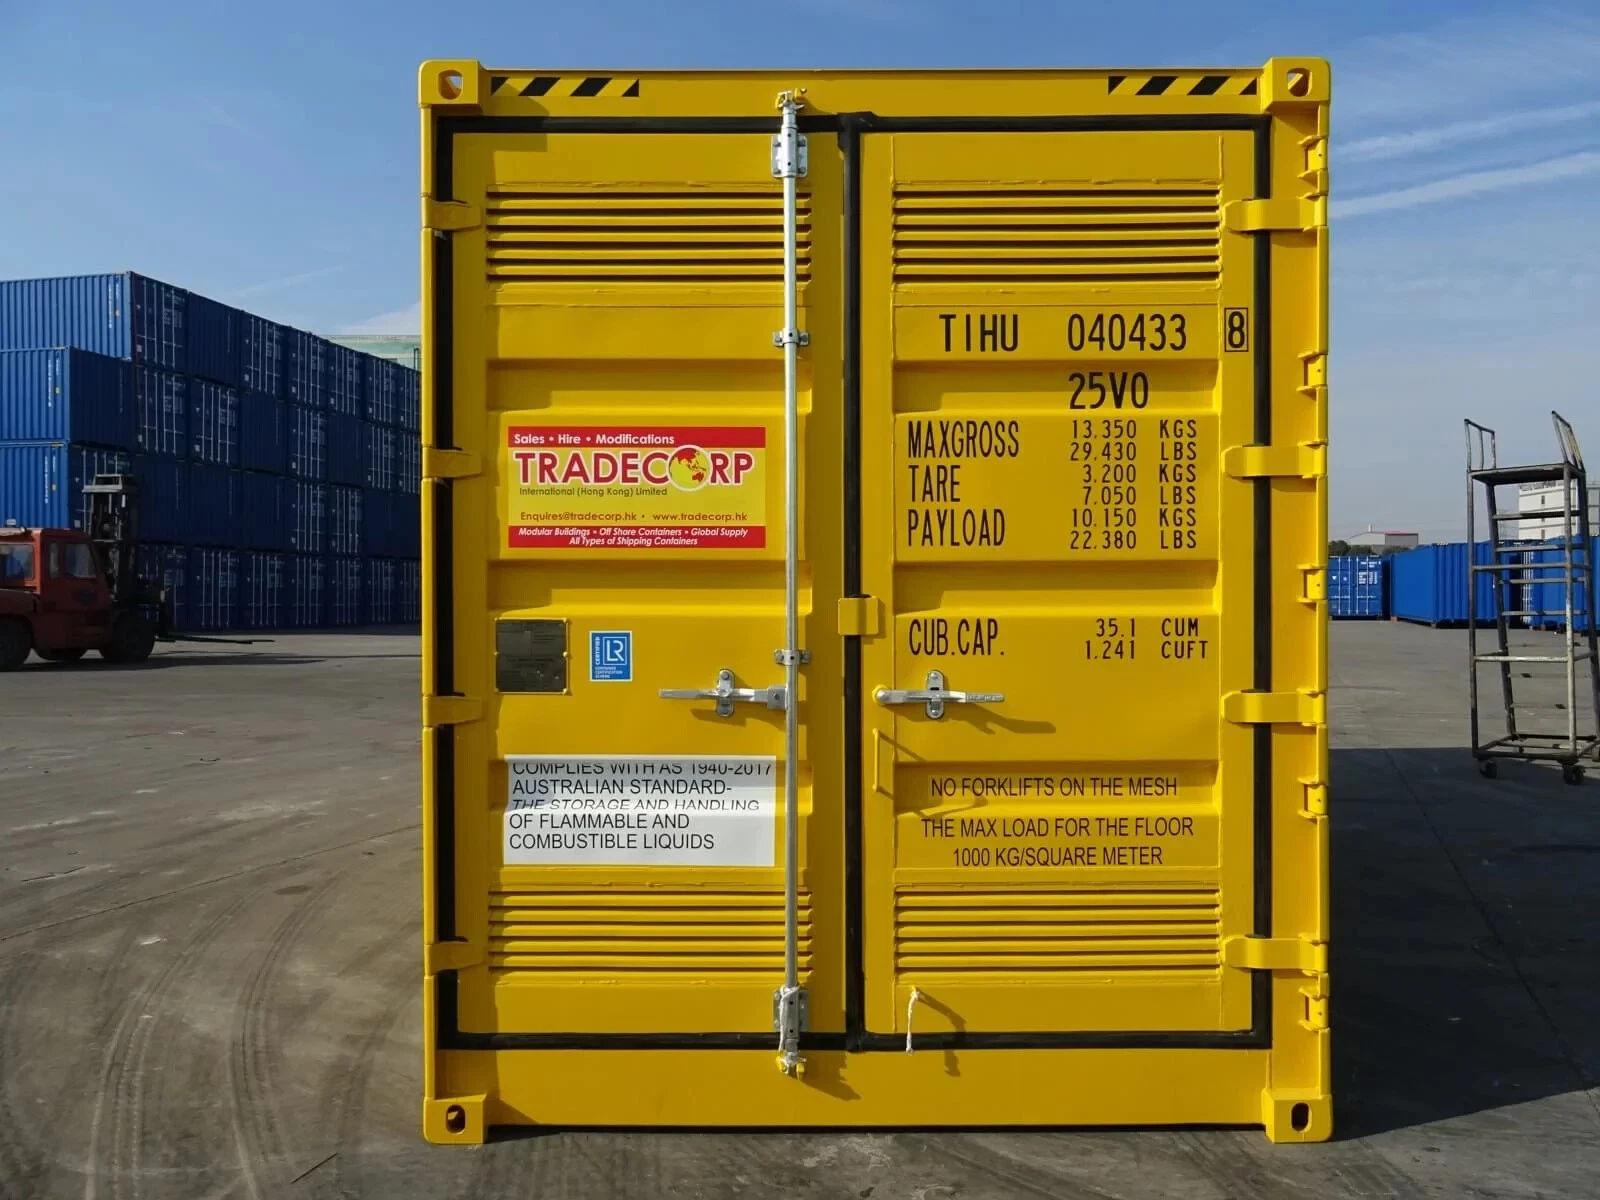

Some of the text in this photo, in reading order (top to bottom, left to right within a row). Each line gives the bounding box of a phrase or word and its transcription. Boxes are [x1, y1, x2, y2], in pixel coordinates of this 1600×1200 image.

[938, 310, 1246, 352] TIHU 040433 8
[1068, 371, 1149, 410] 25V0
[1072, 419, 1197, 439] 13.350 KGS
[514, 433, 675, 445] Sales Hire Modifications
[907, 420, 1020, 459] MAXGROSS
[1070, 441, 1197, 461] 29.430 LBS
[1082, 463, 1197, 483] 3.200 KGS
[519, 487, 667, 497] International (Hong Kong) Limited
[907, 465, 961, 502] TARE
[1083, 486, 1197, 505] 7.050 LBS
[652, 511, 748, 522] www.tradecorp.hk
[1072, 508, 1197, 527] 10.150 KGS
[518, 527, 553, 536] Modular
[554, 527, 591, 537] Buildings
[638, 527, 682, 536] Containers
[690, 527, 719, 536] Global
[720, 527, 749, 538] Supply
[907, 509, 1006, 547] PAYLOAD
[569, 536, 580, 545] All
[580, 536, 605, 547] Types
[617, 536, 652, 547] Shipping
[654, 536, 698, 545] Containers
[1069, 530, 1197, 549] 22.380 LBS
[908, 618, 1005, 656] CUB.CAP.
[1095, 618, 1199, 637] 35.1 CUM
[606, 639, 625, 662] LR
[1085, 640, 1209, 660] 1.241 CUFT
[512, 762, 605, 775] COMPLIES
[610, 762, 655, 775] WITH
[659, 762, 683, 775] AS
[512, 779, 733, 795] AUSTRALIAN STANDARD-
[931, 777, 1178, 798] NO FORKLIFTS ON THE MESH
[512, 799, 760, 811] THE STORAGE AND HANDLING
[509, 813, 690, 829] OF FLAMMABLE AND
[921, 816, 1194, 838] THE MAX LOAD FOR THE FLOOR
[509, 833, 715, 850] COMBUSTIBLE LIQUIDS
[953, 846, 1163, 867] 1000 KG/SQUARE METER
